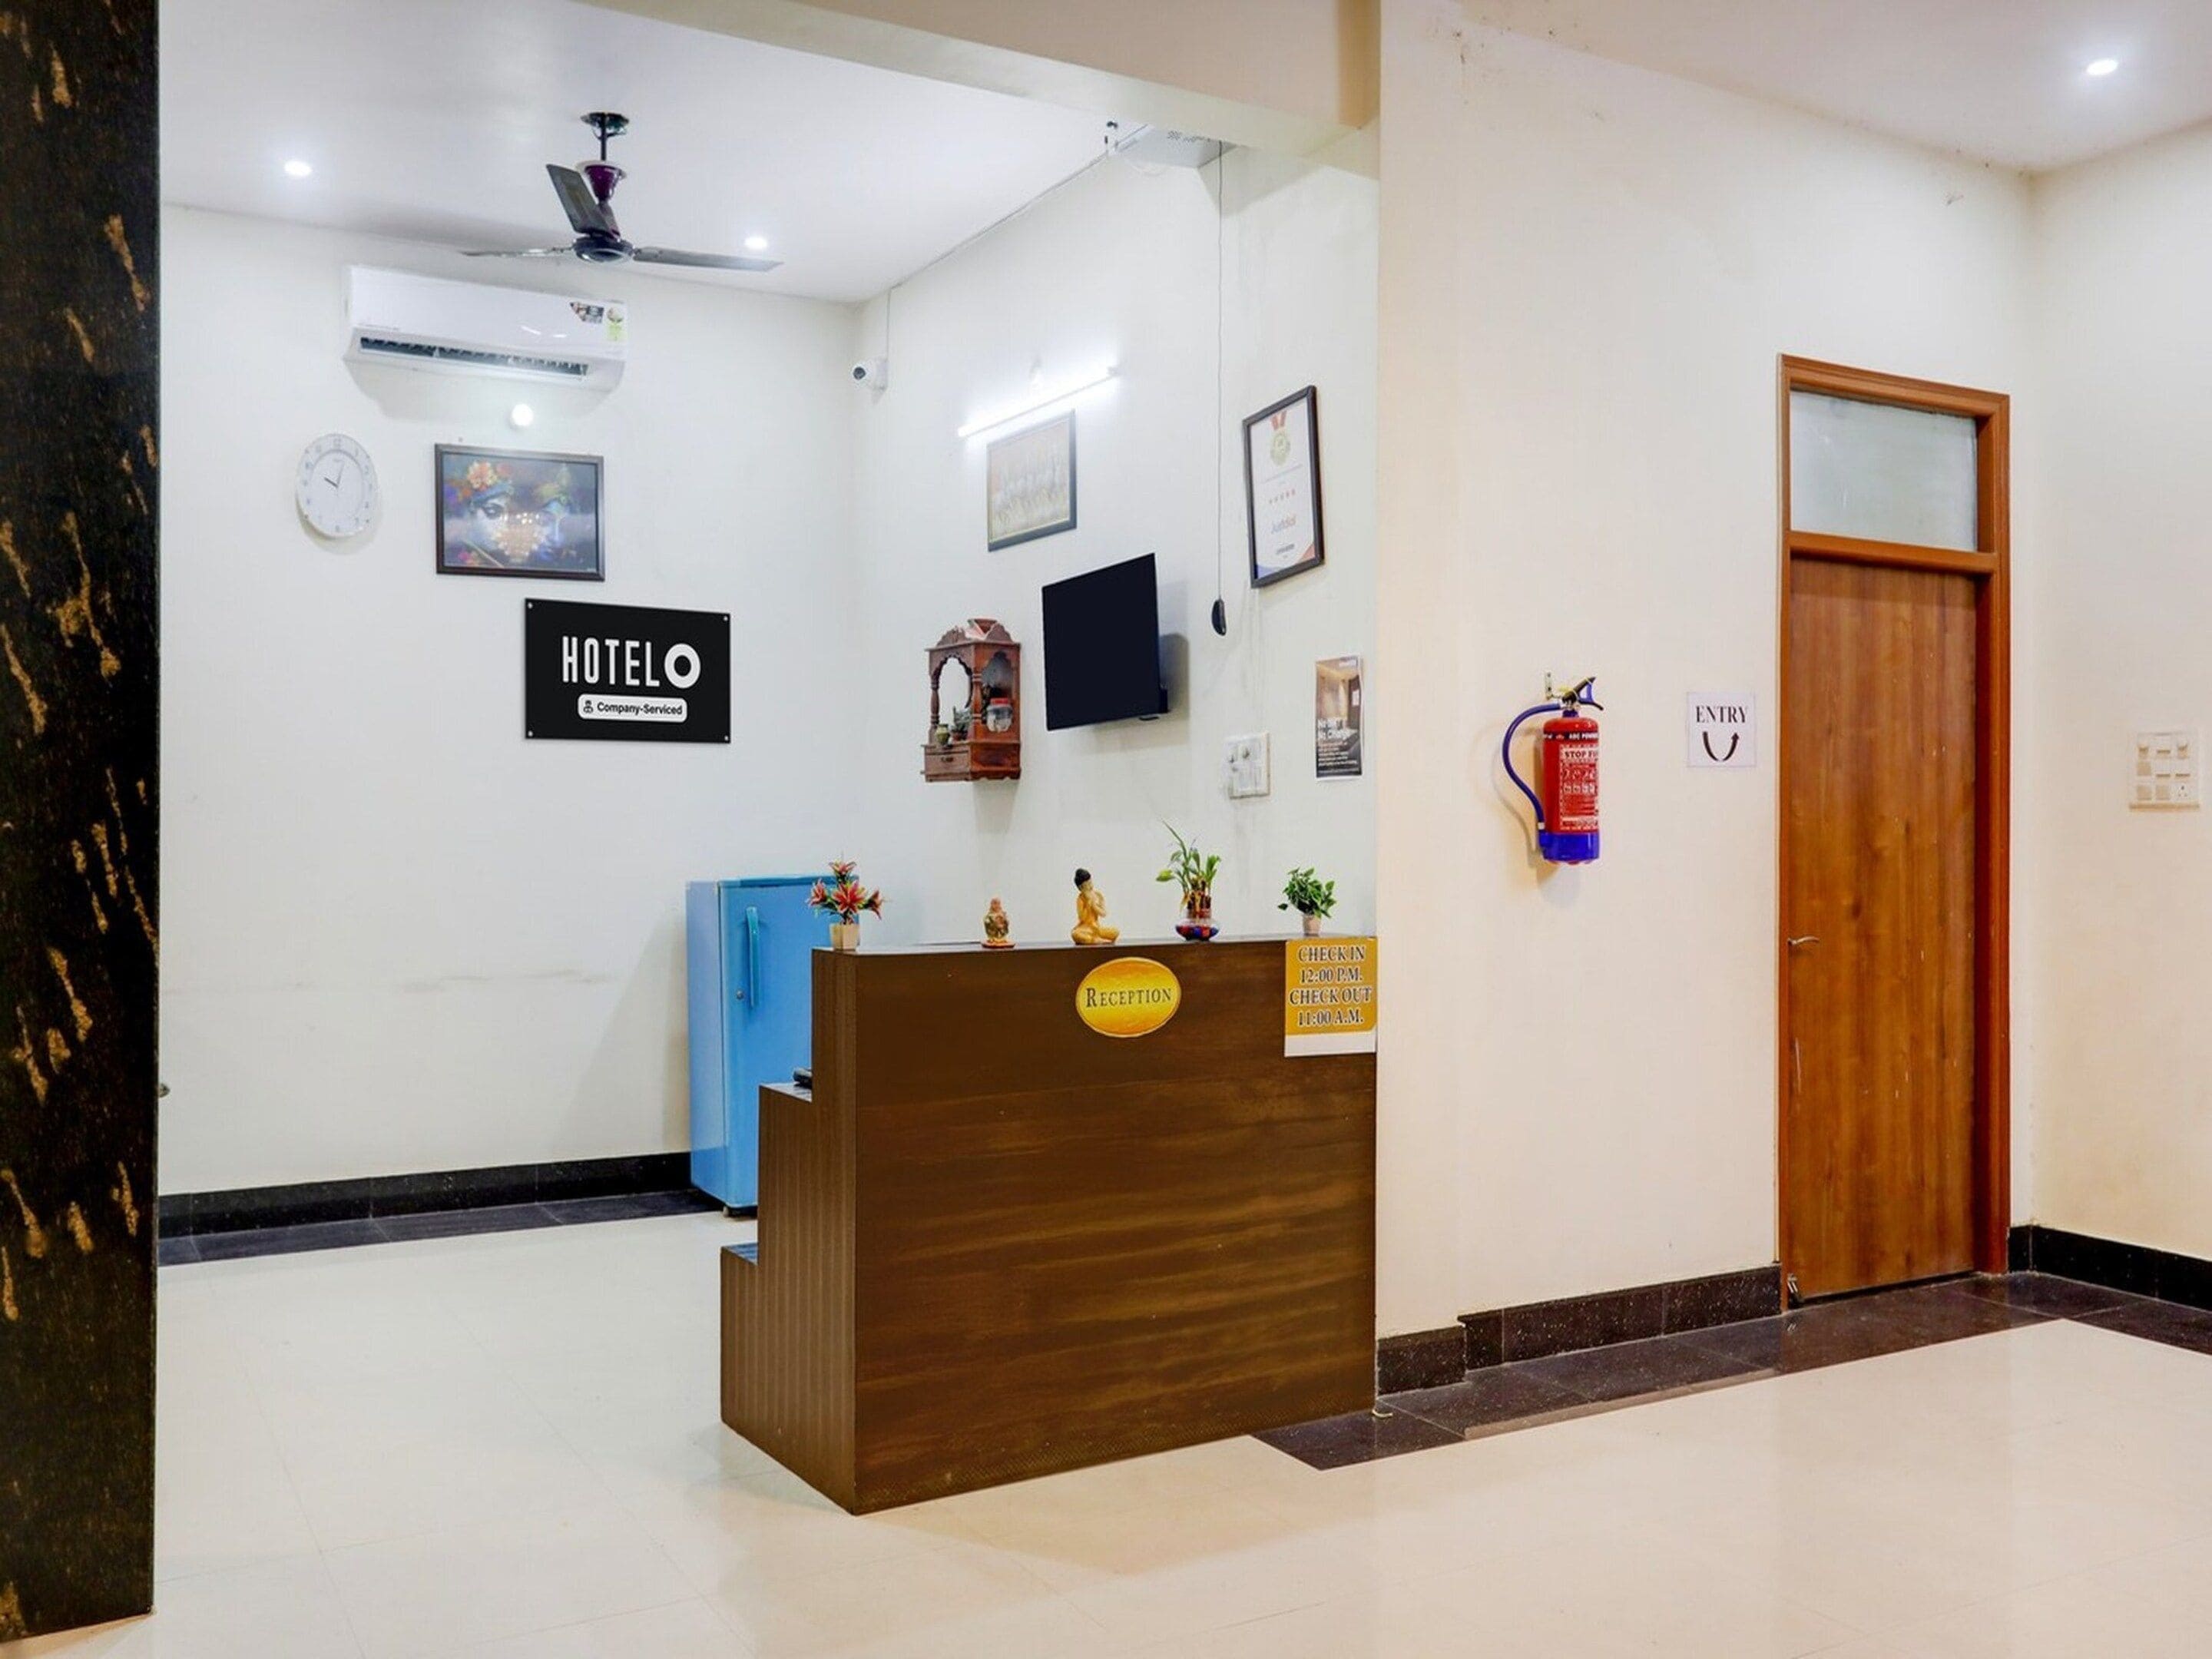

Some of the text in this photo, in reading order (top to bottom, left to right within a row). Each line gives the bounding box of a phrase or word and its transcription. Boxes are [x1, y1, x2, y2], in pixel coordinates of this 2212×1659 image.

[562, 636, 660, 687] HOTEL
[597, 701, 683, 715] Company-Serviced
[1696, 706, 1747, 723] ENTRY
[1298, 946, 1365, 961] CHECK IN
[1301, 968, 1363, 982] 12:00 P.M.
[1086, 988, 1171, 1007] RECEPTION
[1290, 987, 1372, 1004] CHECK OUT
[1299, 1009, 1363, 1025] 11:00 A.M.
